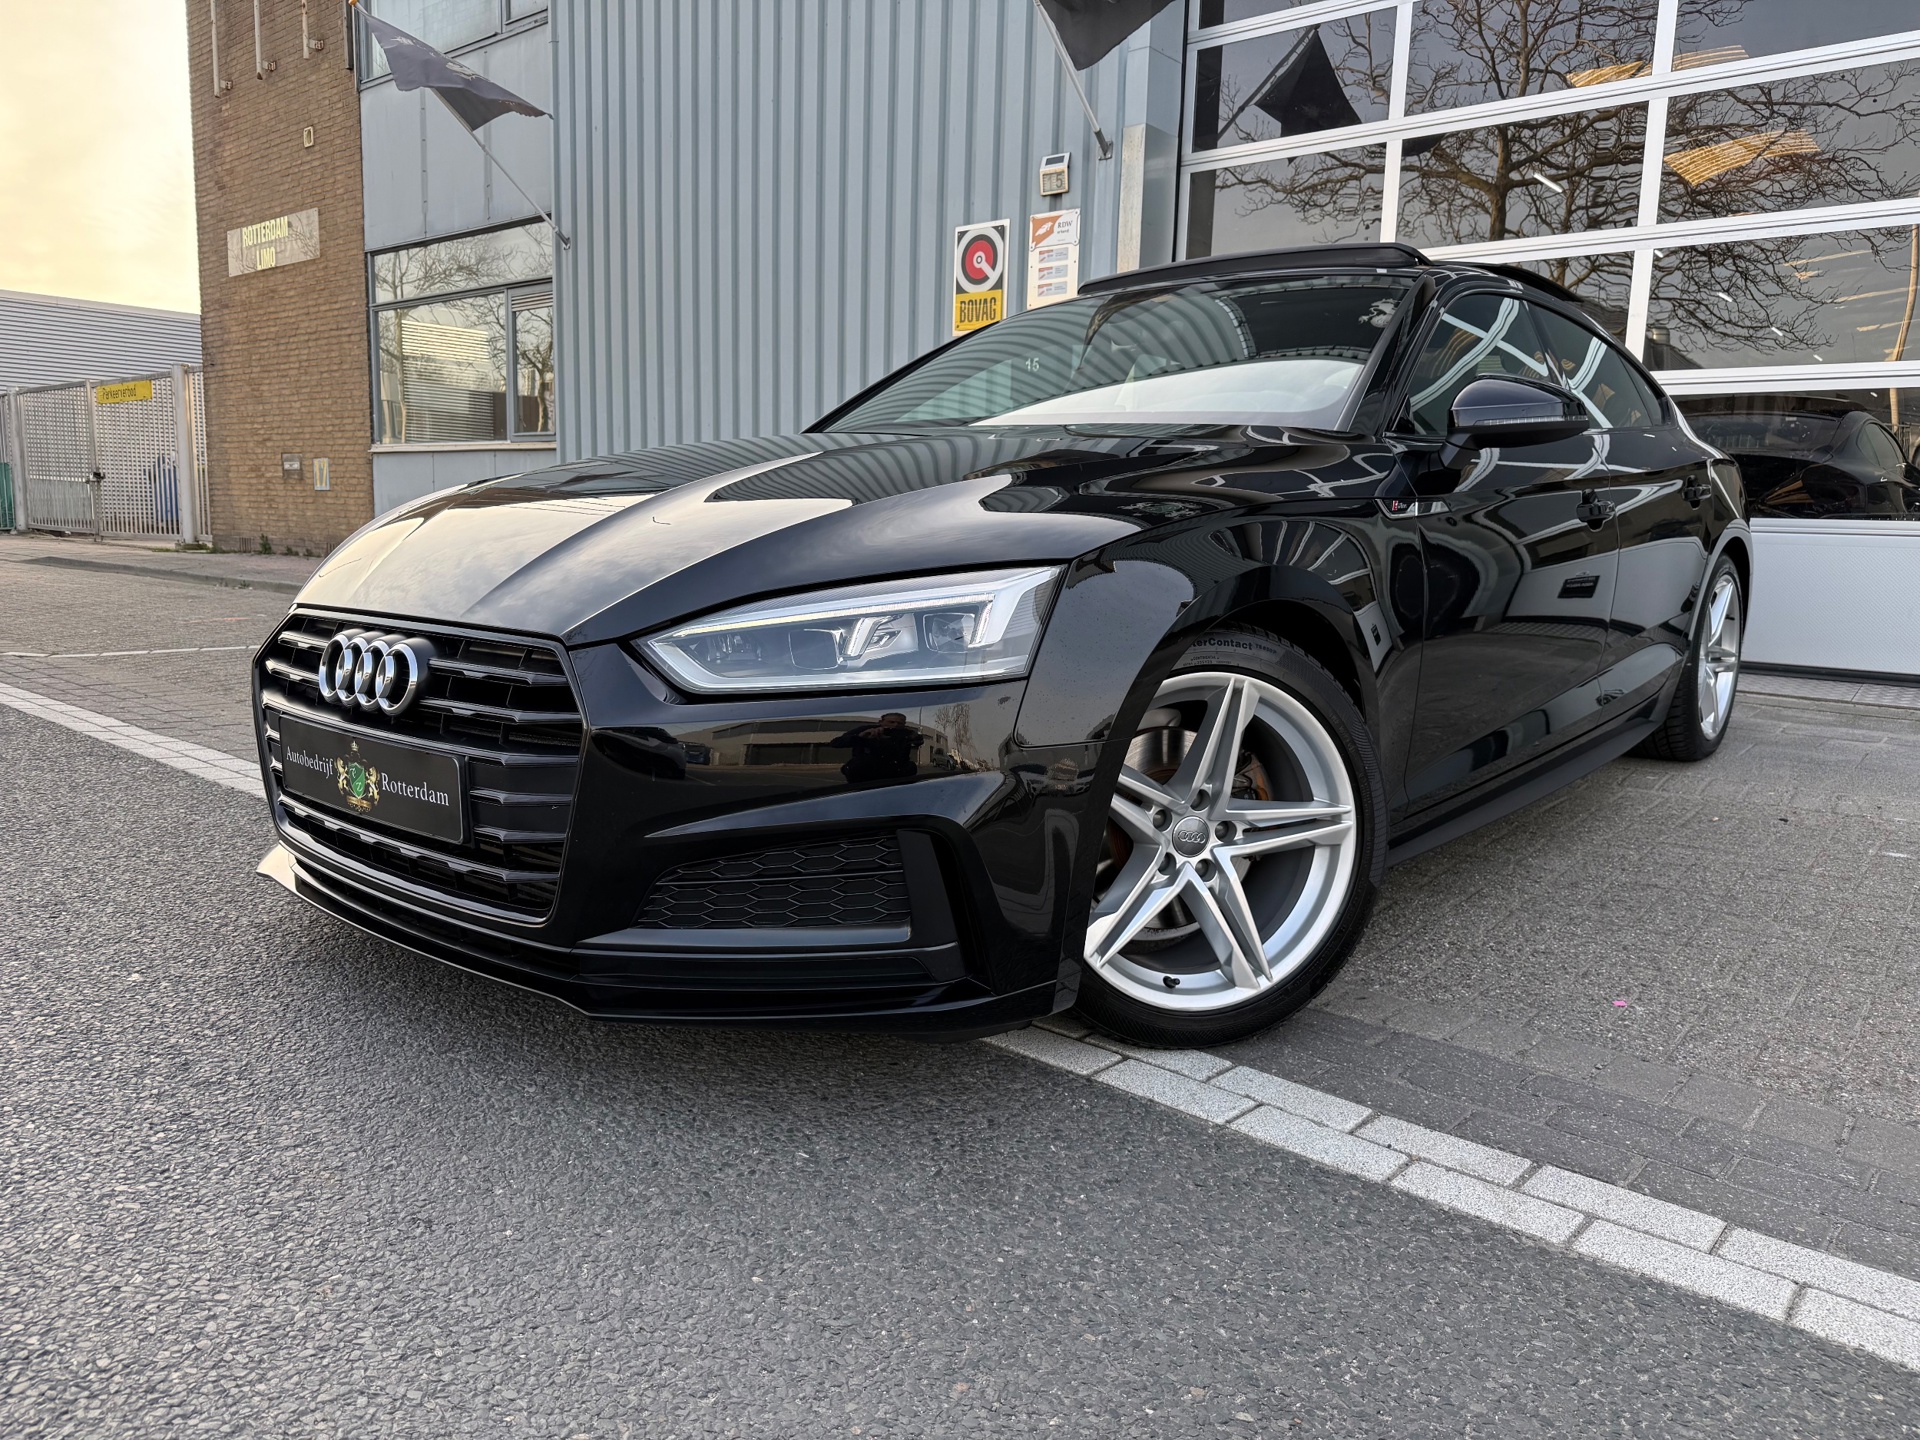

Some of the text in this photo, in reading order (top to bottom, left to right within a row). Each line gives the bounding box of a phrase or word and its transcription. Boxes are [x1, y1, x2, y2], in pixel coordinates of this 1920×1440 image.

[242, 215, 289, 248] ROTTERDAM
[1057, 219, 1073, 229] RDW
[256, 246, 276, 271] LIMO
[959, 296, 997, 323] BOVAG
[1025, 357, 1040, 372] 15
[102, 384, 137, 400] Parkeerverbod
[285, 746, 450, 807] Autobedrijf Rotterdam
